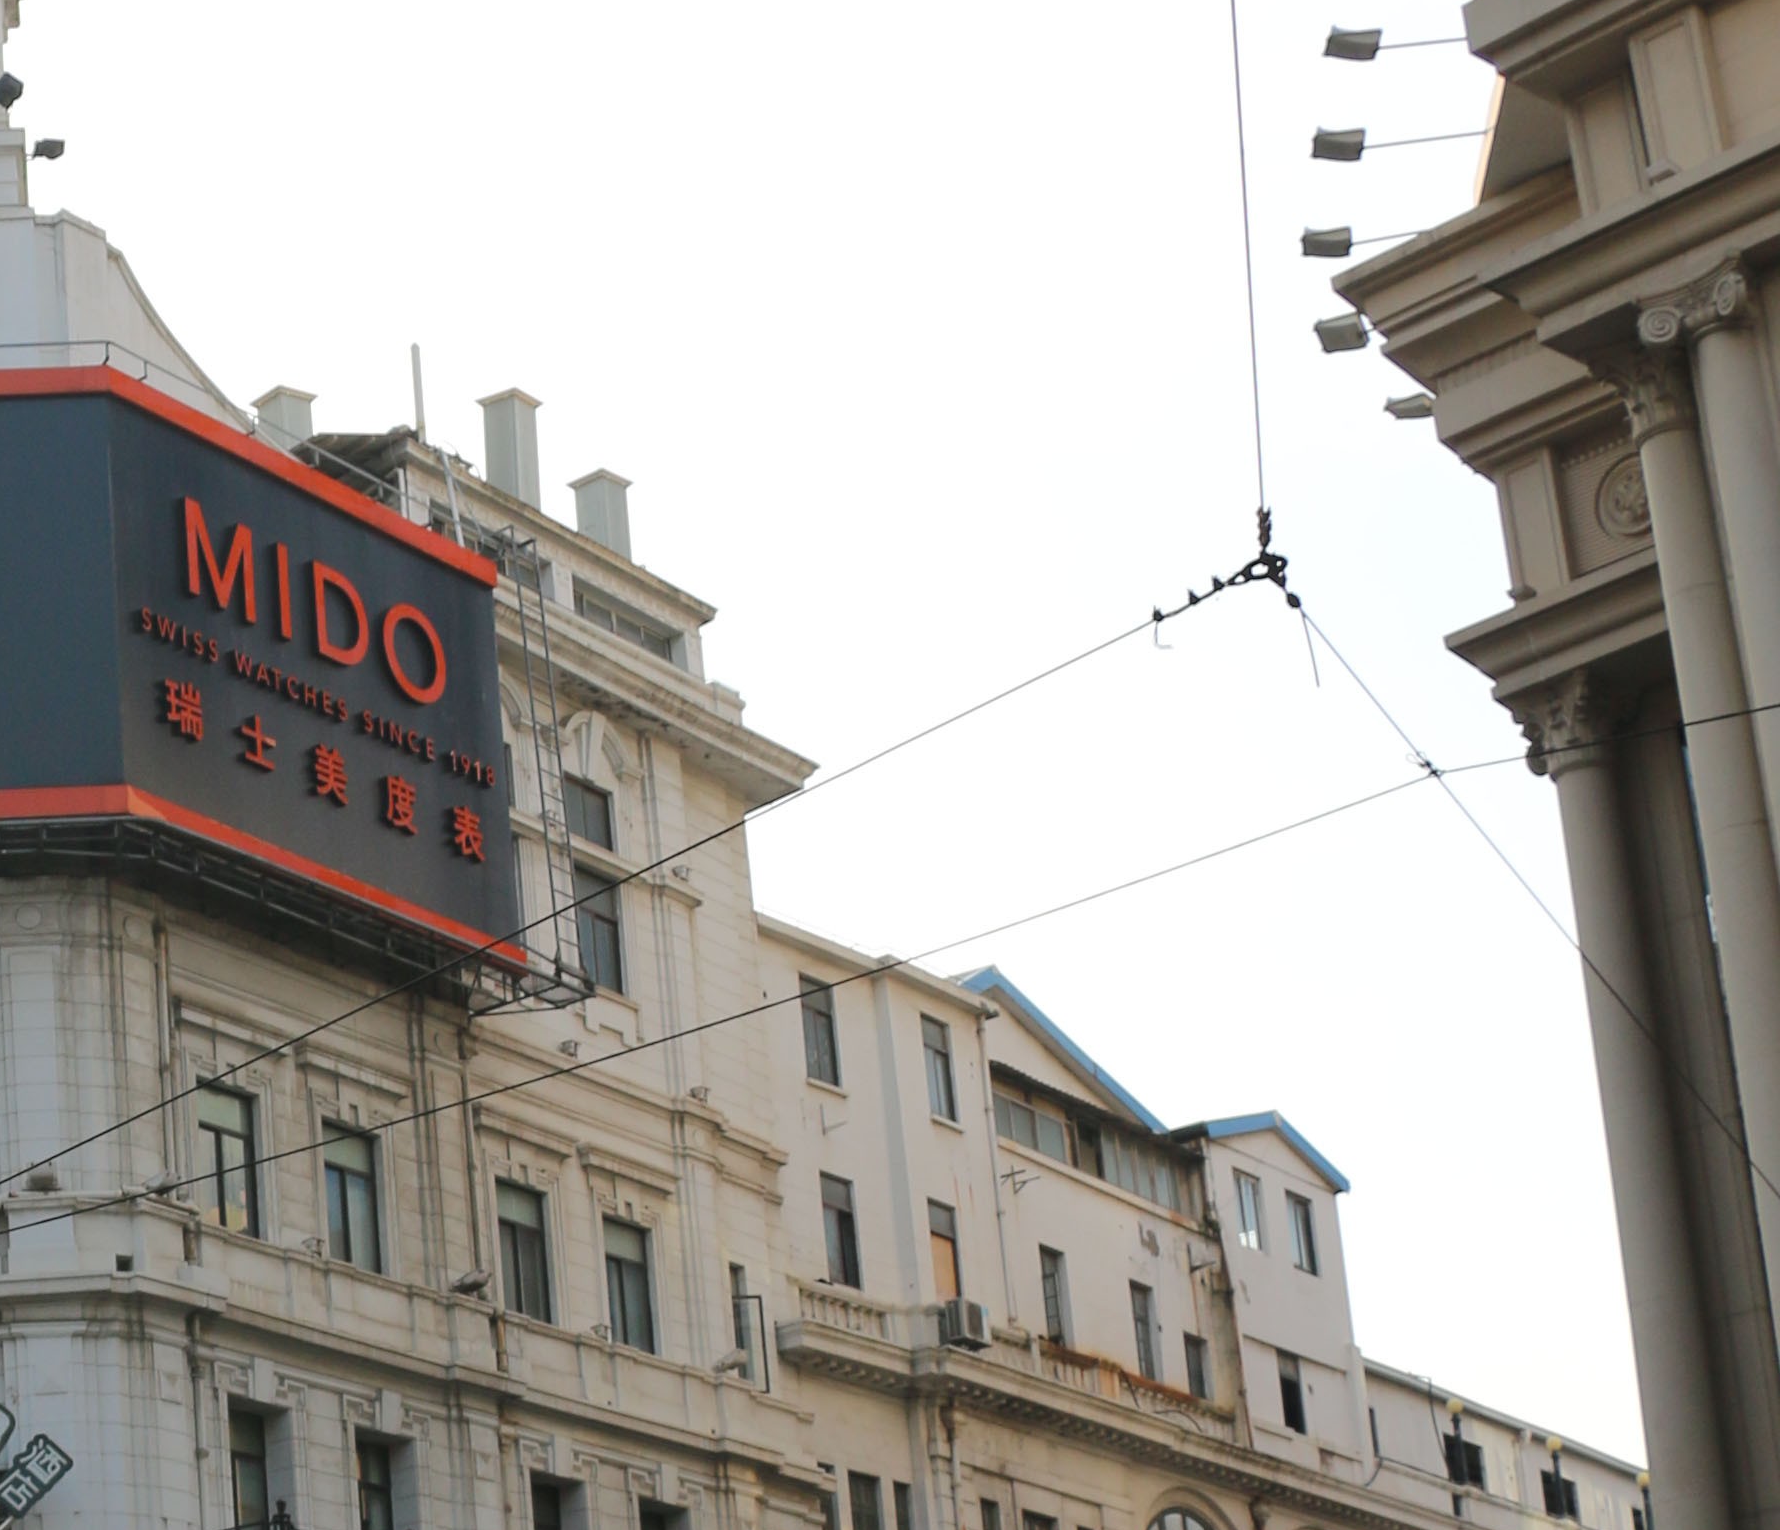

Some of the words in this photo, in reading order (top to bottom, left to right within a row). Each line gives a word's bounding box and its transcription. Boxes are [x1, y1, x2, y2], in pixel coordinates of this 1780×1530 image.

[183, 495, 448, 705] MIDO
[141, 607, 219, 662] SWISS
[234, 648, 349, 722] WATCHES
[362, 709, 436, 762] SINCE
[449, 749, 496, 788] 1918
[164, 676, 487, 863] 瑞士美度表
